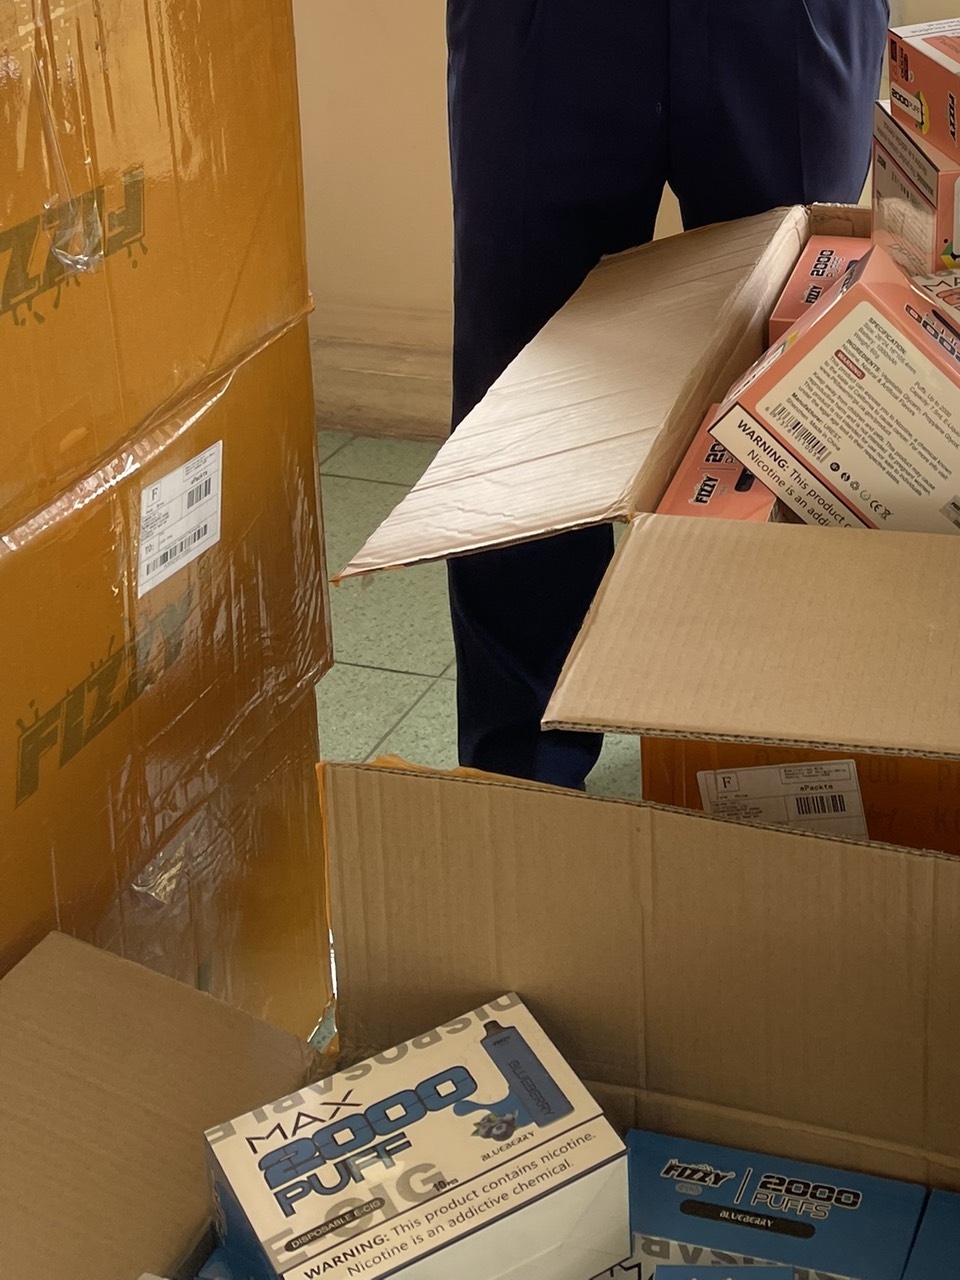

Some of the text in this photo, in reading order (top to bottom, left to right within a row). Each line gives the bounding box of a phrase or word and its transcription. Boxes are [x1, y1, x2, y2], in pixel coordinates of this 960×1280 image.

[810, 249, 835, 278] 2000
[804, 284, 822, 305] FIZZY
[897, 398, 916, 416] Flavors
[938, 404, 951, 418] 2000
[826, 436, 841, 451] China
[735, 419, 846, 525] WARNING: This product
[746, 448, 788, 488] Nicotine
[784, 484, 796, 496] is
[793, 492, 809, 508] an
[151, 489, 159, 504] F
[693, 474, 720, 506] FIZZY
[722, 776, 732, 789] F
[508, 1059, 554, 1117] BLUEBERRY
[245, 1088, 364, 1155] MAX
[257, 1065, 478, 1192] 2000
[480, 1130, 536, 1162] BLUEBERRY
[273, 1130, 414, 1219] PUFF
[660, 1160, 863, 1209] FIZZY 2000
[304, 1132, 597, 1280] WARNING: This product contains nicotine.
[347, 1159, 575, 1277] Nicotine is an addictive chemical.
[719, 1209, 774, 1228] BLUEBERRY
[751, 1190, 832, 1219] PUFFS
[290, 1201, 381, 1248] DISPOSABLE E-CIG
